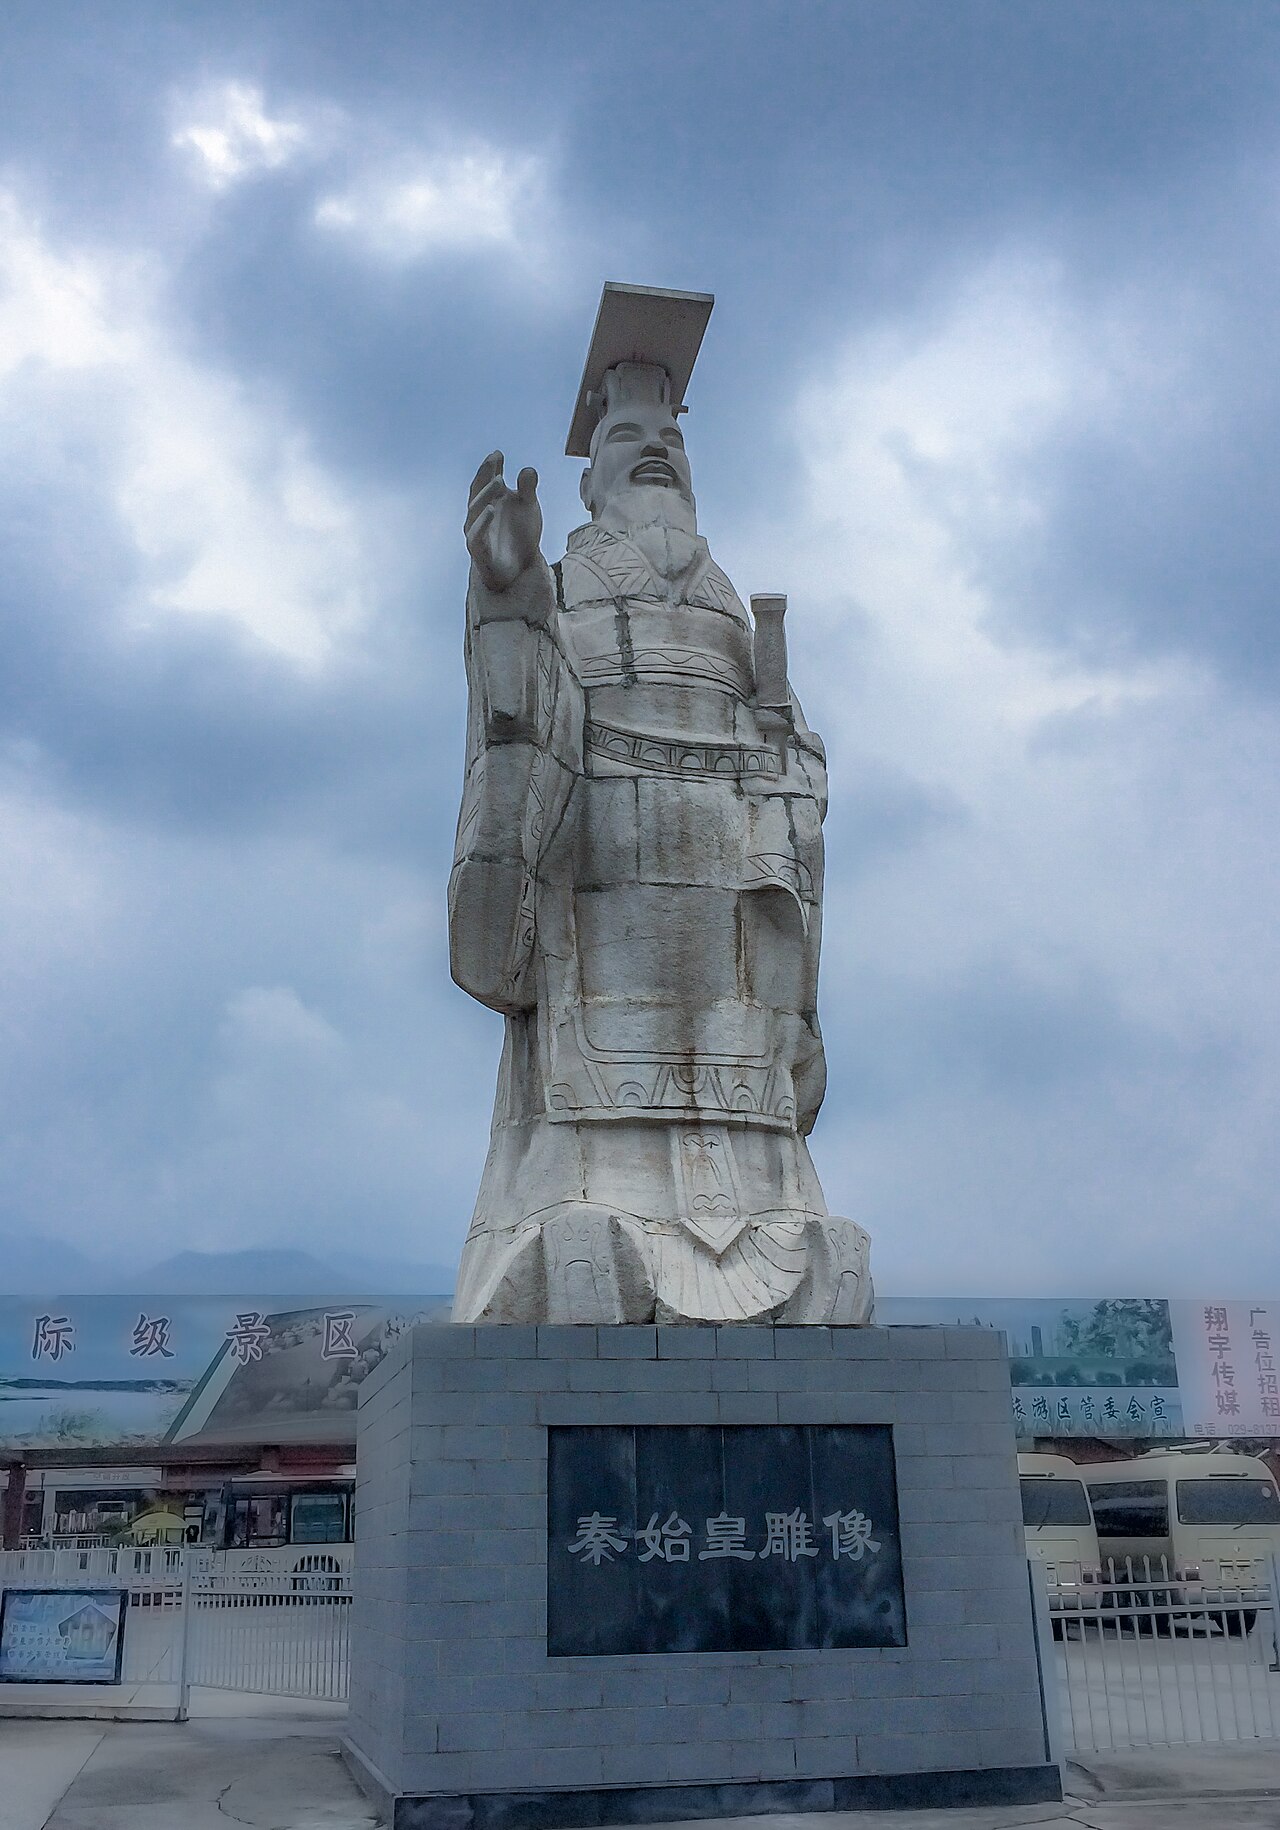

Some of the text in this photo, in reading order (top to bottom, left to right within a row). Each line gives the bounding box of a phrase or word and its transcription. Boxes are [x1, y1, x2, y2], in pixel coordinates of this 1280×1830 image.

[1204, 1306, 1240, 1416] 翔宇传媒
[1249, 1307, 1280, 1417] 广告位招租
[1228, 1424, 1280, 1435] 029-8137
[567, 1506, 882, 1565] 秦始皇雕像
